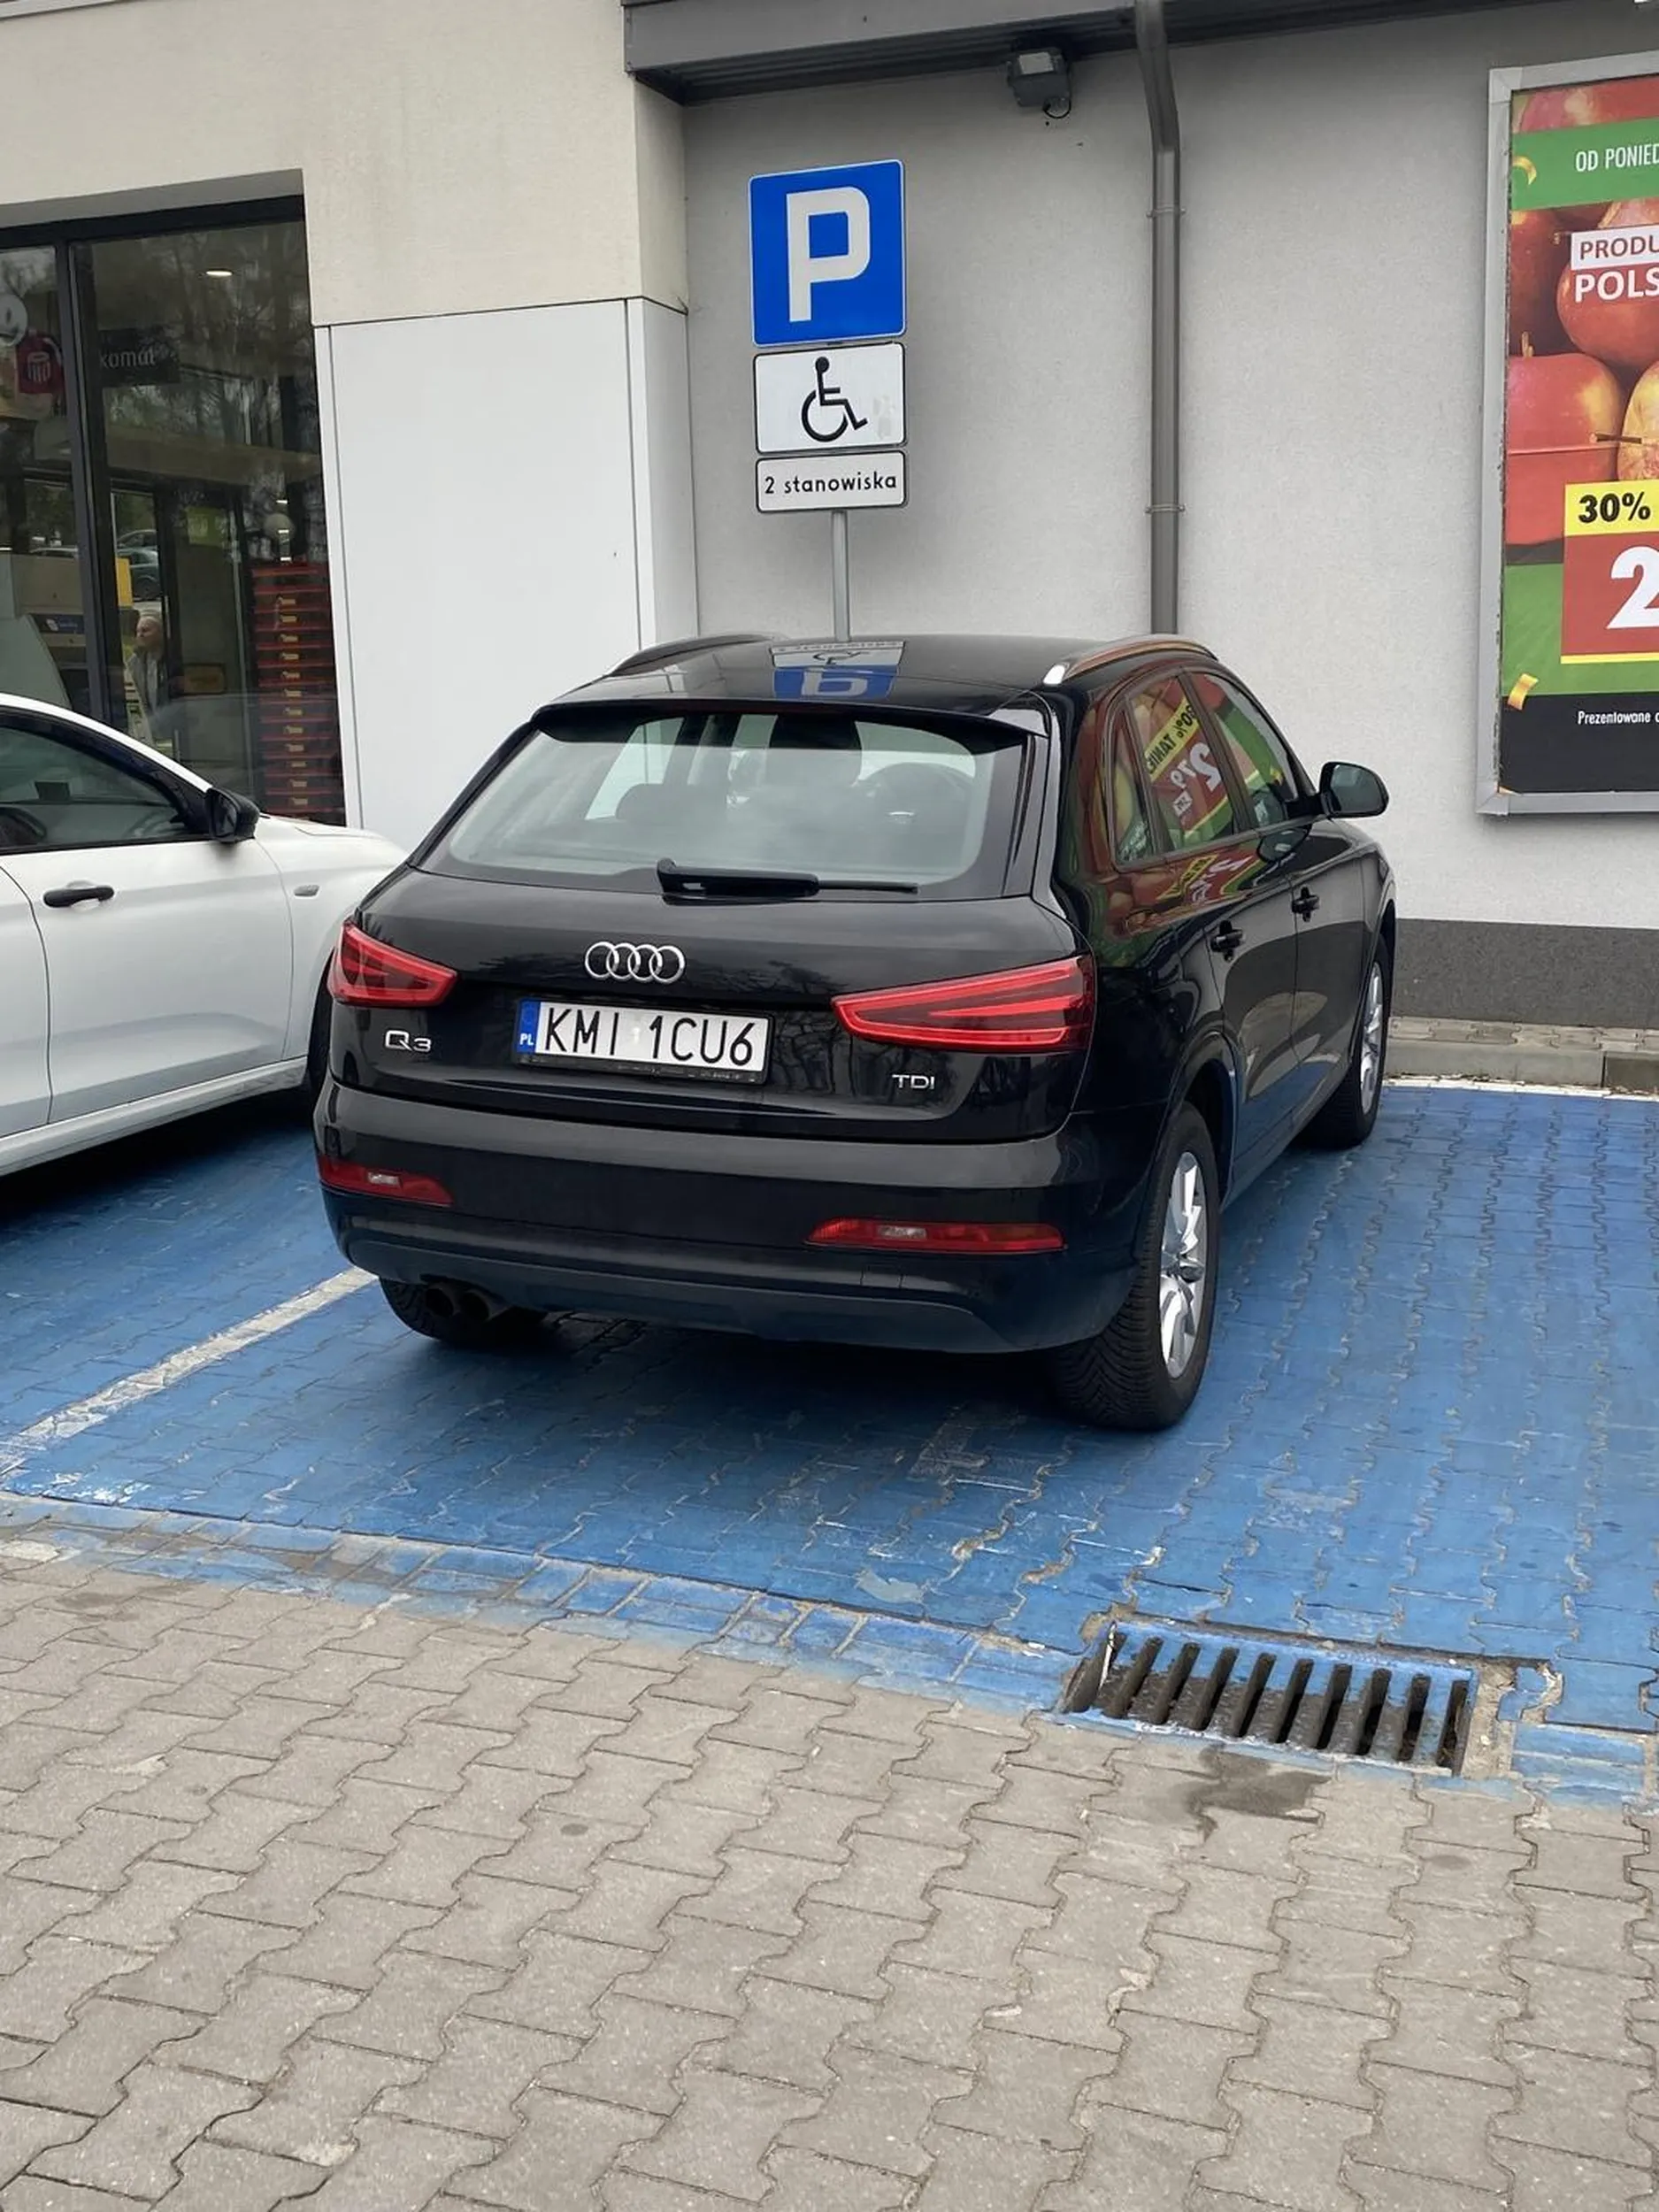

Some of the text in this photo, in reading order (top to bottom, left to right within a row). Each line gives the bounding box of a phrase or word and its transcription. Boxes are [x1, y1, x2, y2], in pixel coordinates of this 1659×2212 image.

[1576, 150, 1598, 172] OD
[786, 186, 871, 323] P
[764, 471, 896, 495] 2 stanowiska
[1578, 492, 1651, 524] 30%
[1605, 546, 1659, 629] 2
[1578, 710, 1652, 726] Prezentowane
[385, 1030, 432, 1052] Q3
[519, 1033, 534, 1046] PL
[545, 1007, 756, 1066] KMI 1CU6
[892, 1074, 935, 1090] TDI
